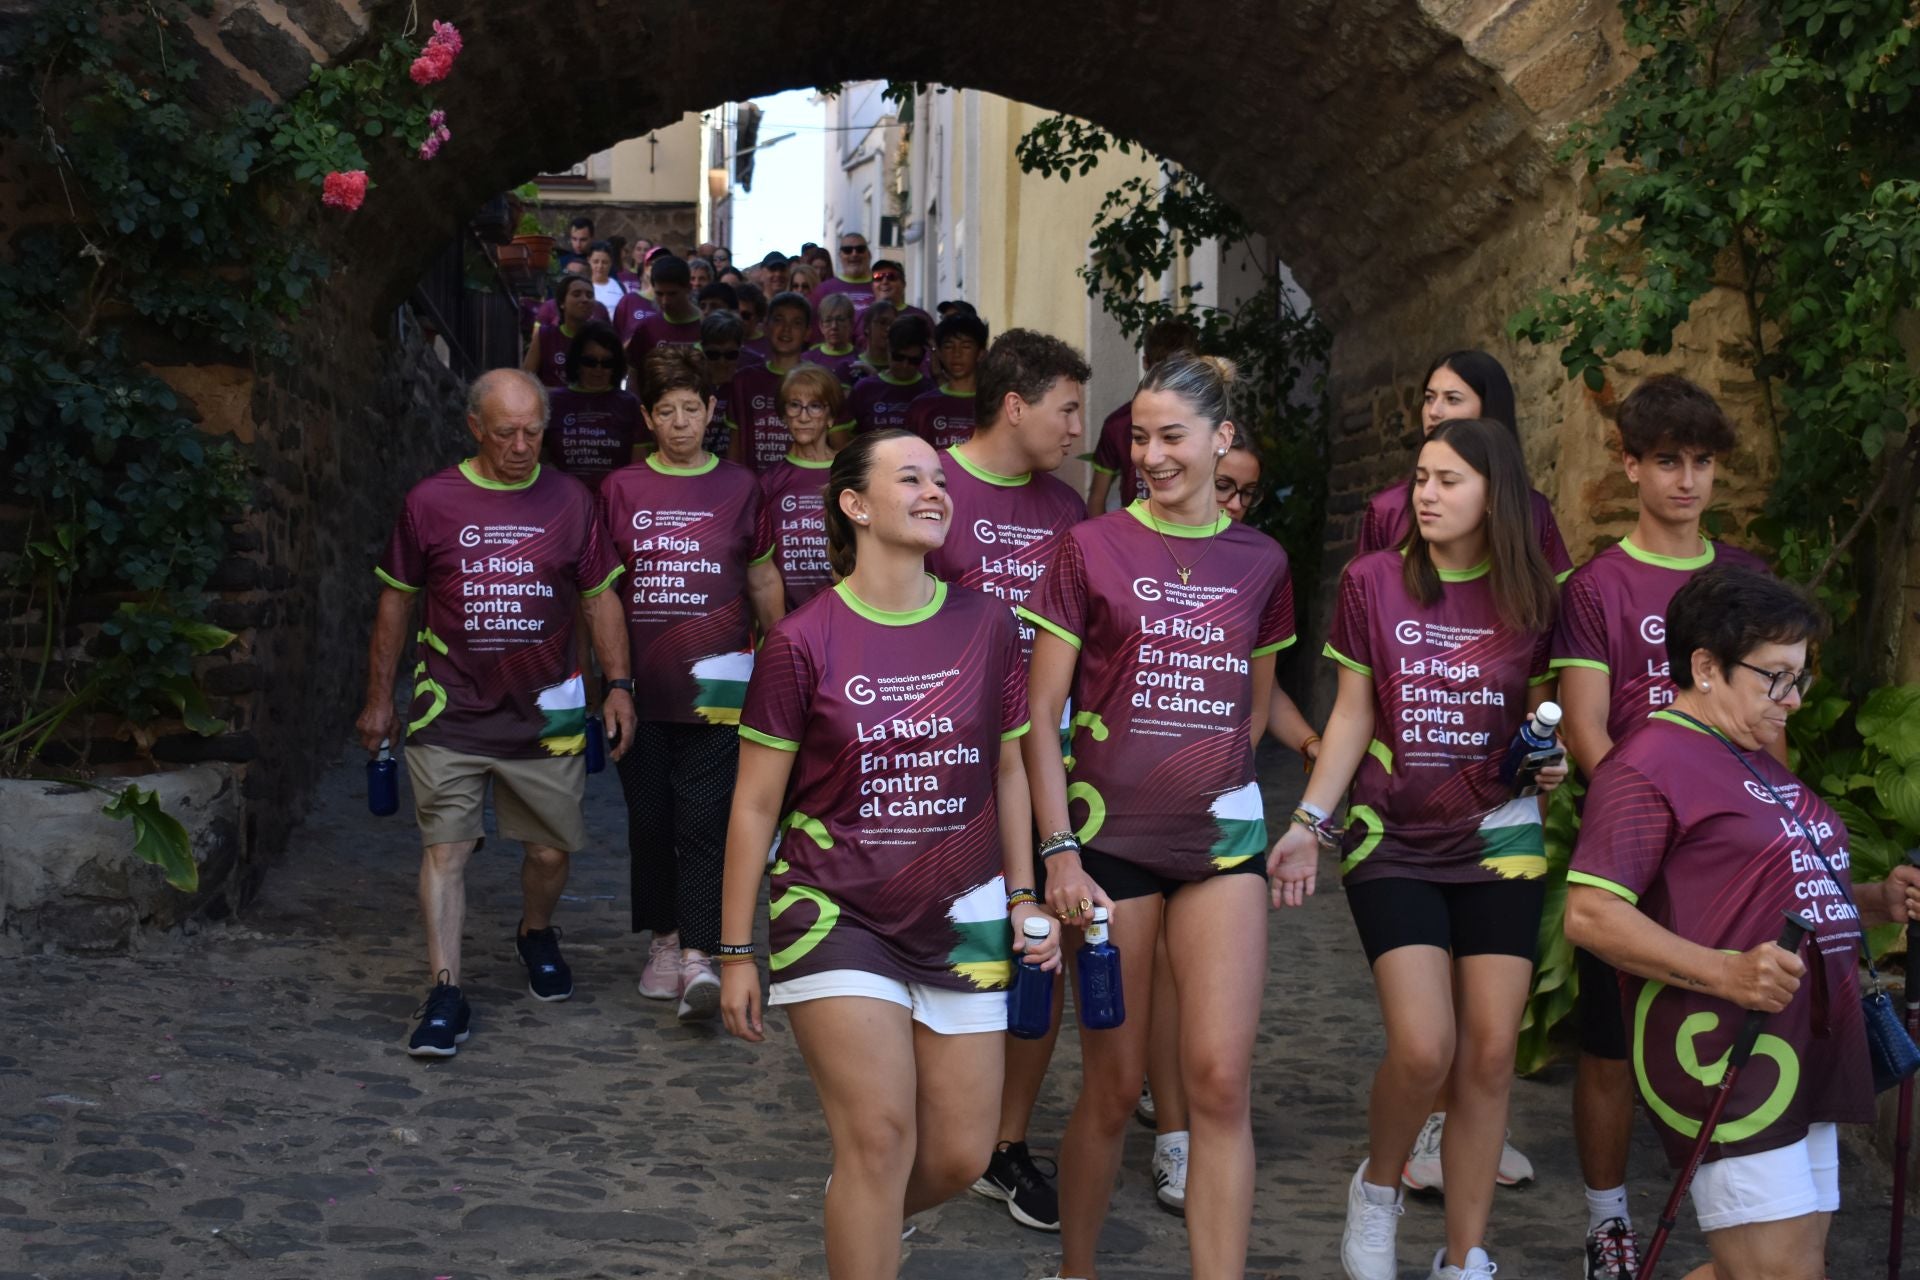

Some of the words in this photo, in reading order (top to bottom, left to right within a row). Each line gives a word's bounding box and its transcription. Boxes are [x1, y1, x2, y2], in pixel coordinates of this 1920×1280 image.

[579, 428, 606, 436] Rioja
[579, 438, 621, 447] marcha
[782, 520, 798, 529] La
[802, 518, 825, 531] Rioj
[634, 539, 653, 552] La
[658, 537, 699, 554] Rioja
[783, 535, 799, 546] En
[803, 536, 830, 545] mar
[783, 547, 825, 558] contra
[462, 559, 483, 573] La
[489, 558, 533, 575] Rioja
[635, 558, 652, 572] En
[657, 558, 721, 574] marcha
[784, 560, 796, 570] el
[800, 560, 832, 570] cánc
[982, 556, 1002, 573] La
[463, 582, 484, 596] En
[490, 581, 553, 597] marcha
[634, 574, 684, 588] contra
[1164, 582, 1201, 592] asociación
[634, 590, 644, 603] el
[649, 590, 708, 604] cáncer
[1165, 589, 1187, 598] contra
[464, 598, 522, 613] contra
[1186, 600, 1204, 608] Rioja
[464, 616, 480, 630] el
[484, 615, 544, 630] cáncer
[1140, 616, 1166, 634] La
[1172, 618, 1224, 644] Rioja
[1444, 641, 1461, 649] Rioja
[1138, 645, 1163, 664] En
[1169, 653, 1248, 675] marcha
[1648, 659, 1670, 676] La
[878, 675, 919, 684] asociación
[922, 669, 960, 681] española
[1401, 658, 1425, 674] La
[1431, 659, 1479, 682] Rioja
[880, 684, 904, 692] contra
[916, 680, 944, 690] cáncer
[1136, 670, 1204, 692] contra
[904, 692, 925, 701] Rioja
[1132, 689, 1151, 708] el
[1158, 693, 1234, 716] cáncer
[1402, 685, 1427, 702] En
[1430, 687, 1504, 706] marcha
[1649, 687, 1673, 705] En
[1402, 707, 1464, 725] contra
[857, 722, 886, 742] La
[893, 714, 953, 739] Rioja
[1402, 724, 1422, 742] el
[1427, 726, 1490, 745] cáncer
[861, 752, 887, 774] En
[895, 744, 979, 769] marcha
[861, 773, 938, 796] contra
[859, 797, 881, 818] el
[888, 795, 966, 817] cáncer
[1791, 849, 1813, 873] En
[1800, 901, 1824, 923] el
